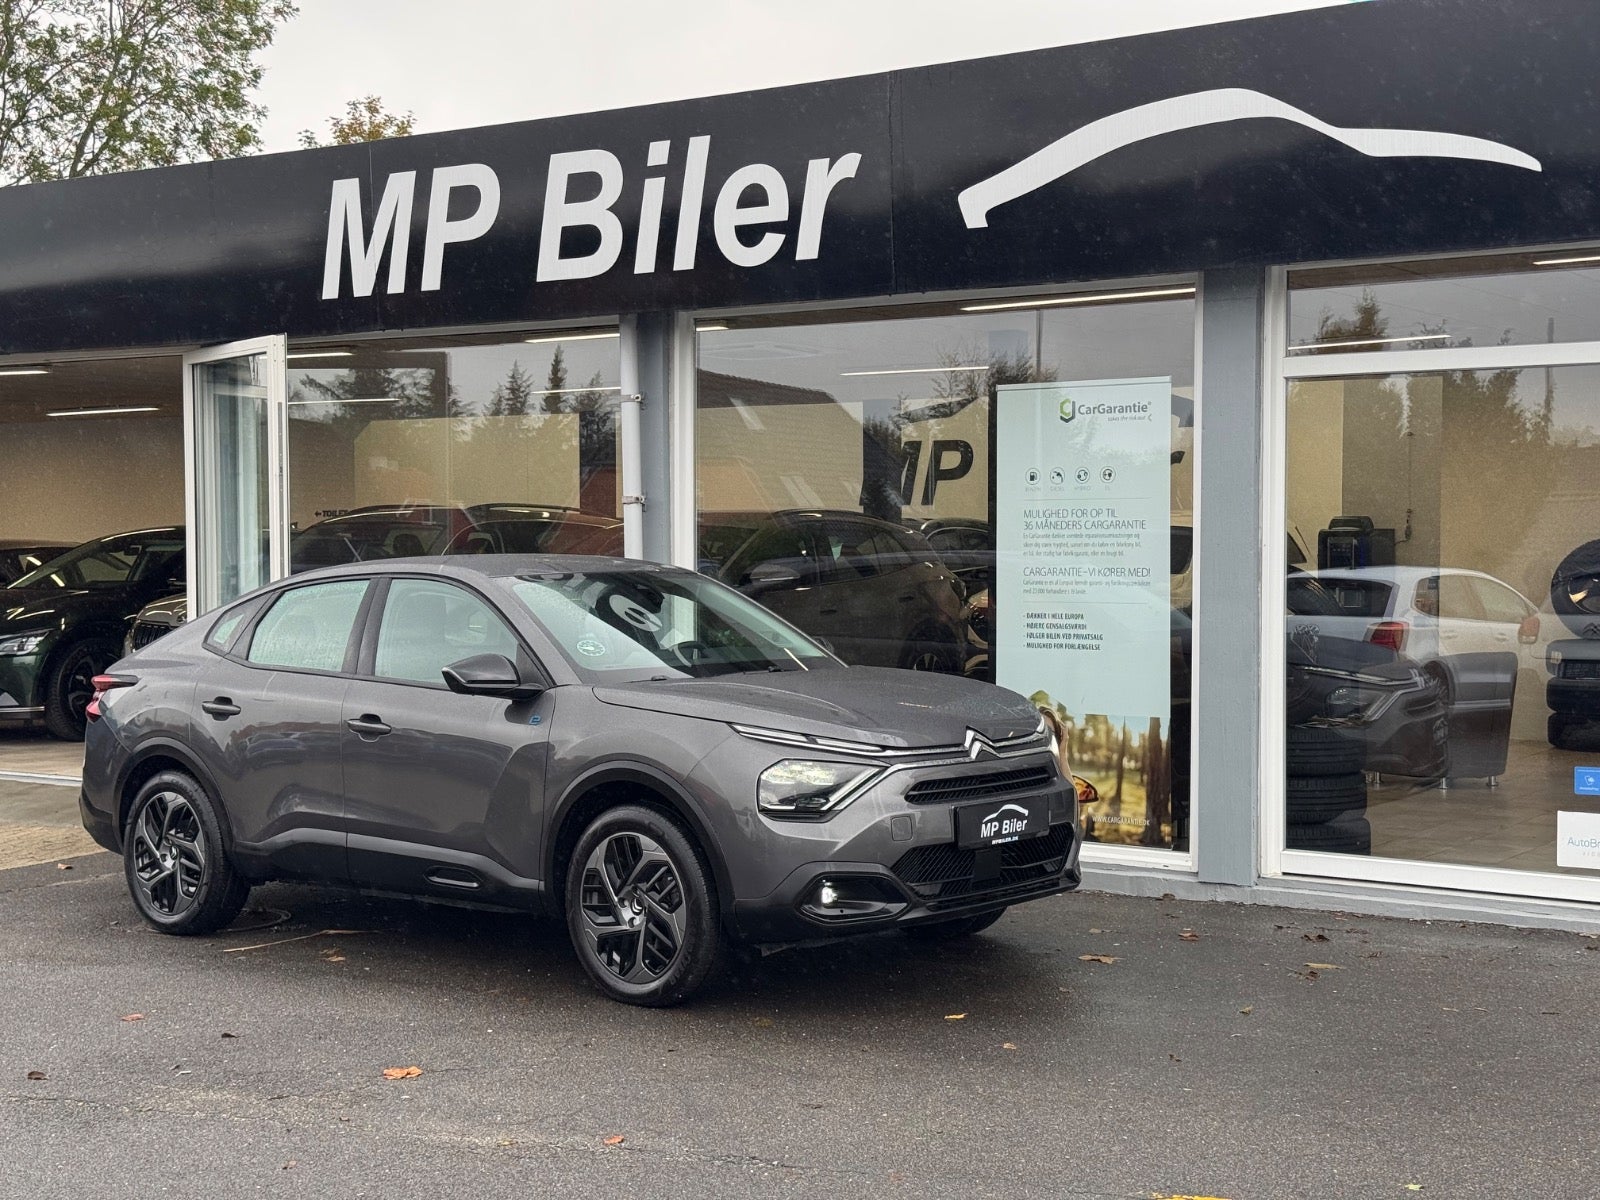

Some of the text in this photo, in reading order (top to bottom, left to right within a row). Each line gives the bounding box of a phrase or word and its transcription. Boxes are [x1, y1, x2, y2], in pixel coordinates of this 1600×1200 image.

[322, 135, 863, 300] MP Biler
[1023, 508, 1119, 519] MULIGHED FOR OP TIL
[1023, 518, 1147, 531] 36 MÅNEDERS CARGARANTIE
[1097, 567, 1126, 577] KØRER
[1128, 567, 1151, 578] MED!
[1026, 612, 1047, 620] DÆKKER
[1051, 612, 1064, 620] HELE
[1026, 632, 1045, 640] FØLGER
[1046, 632, 1060, 640] BILEN
[1072, 633, 1104, 641] PRIVATSALG
[1026, 642, 1101, 651] MULIGHED FOR FORLÆNGELSE
[981, 818, 1028, 838] MP Biler
